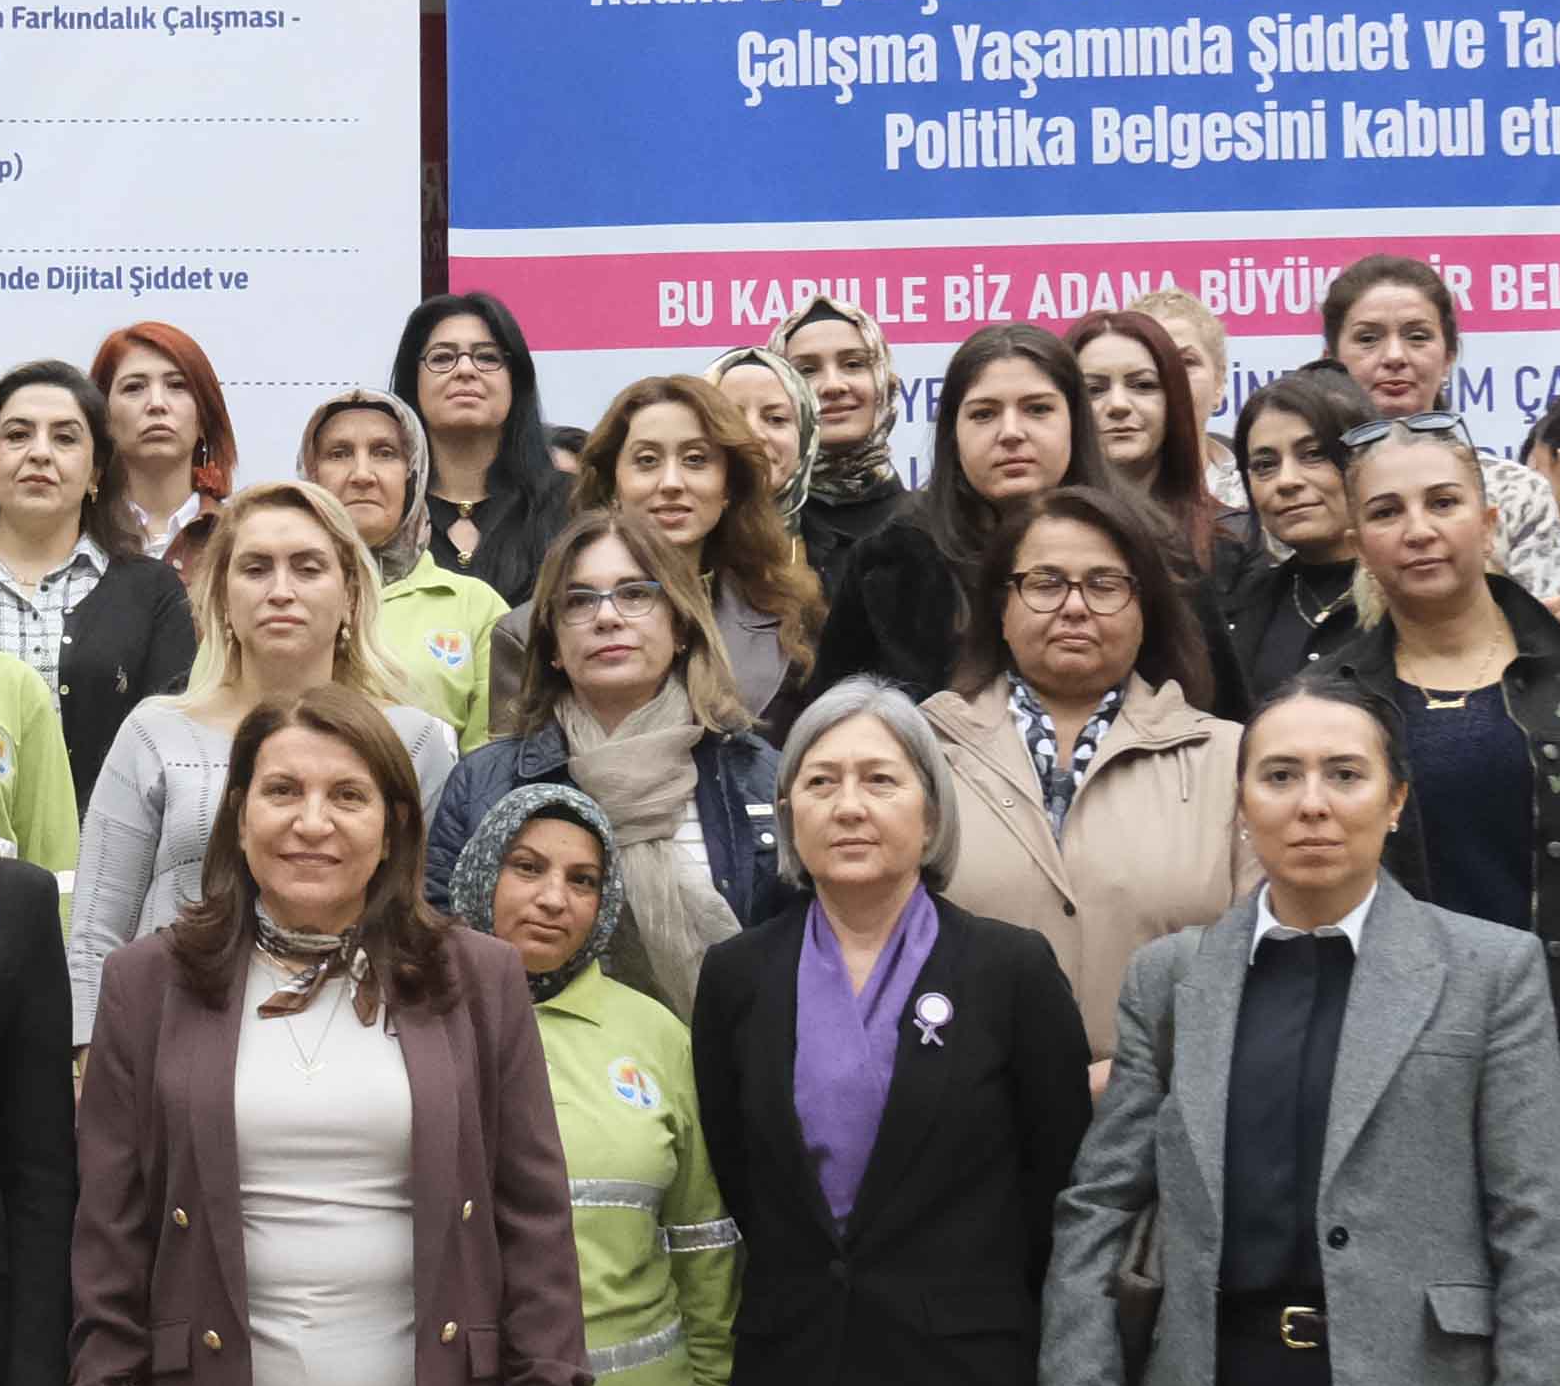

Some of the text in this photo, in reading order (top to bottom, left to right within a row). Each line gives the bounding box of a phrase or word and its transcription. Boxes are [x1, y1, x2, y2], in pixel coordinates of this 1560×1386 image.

[737, 28, 938, 106] Çalışma
[951, 17, 1234, 99] Yaşamında
[1247, 12, 1411, 92] Şiddet
[1422, 18, 1486, 70] ve
[885, 106, 1076, 171] Politika
[1091, 98, 1327, 170] Belgesini
[1341, 98, 1486, 159] kabul
[46, 265, 123, 296] Dijital
[129, 265, 214, 298] Şiddet
[218, 271, 249, 290] ve
[658, 278, 713, 327] BU
[944, 264, 1011, 321] BİZ
